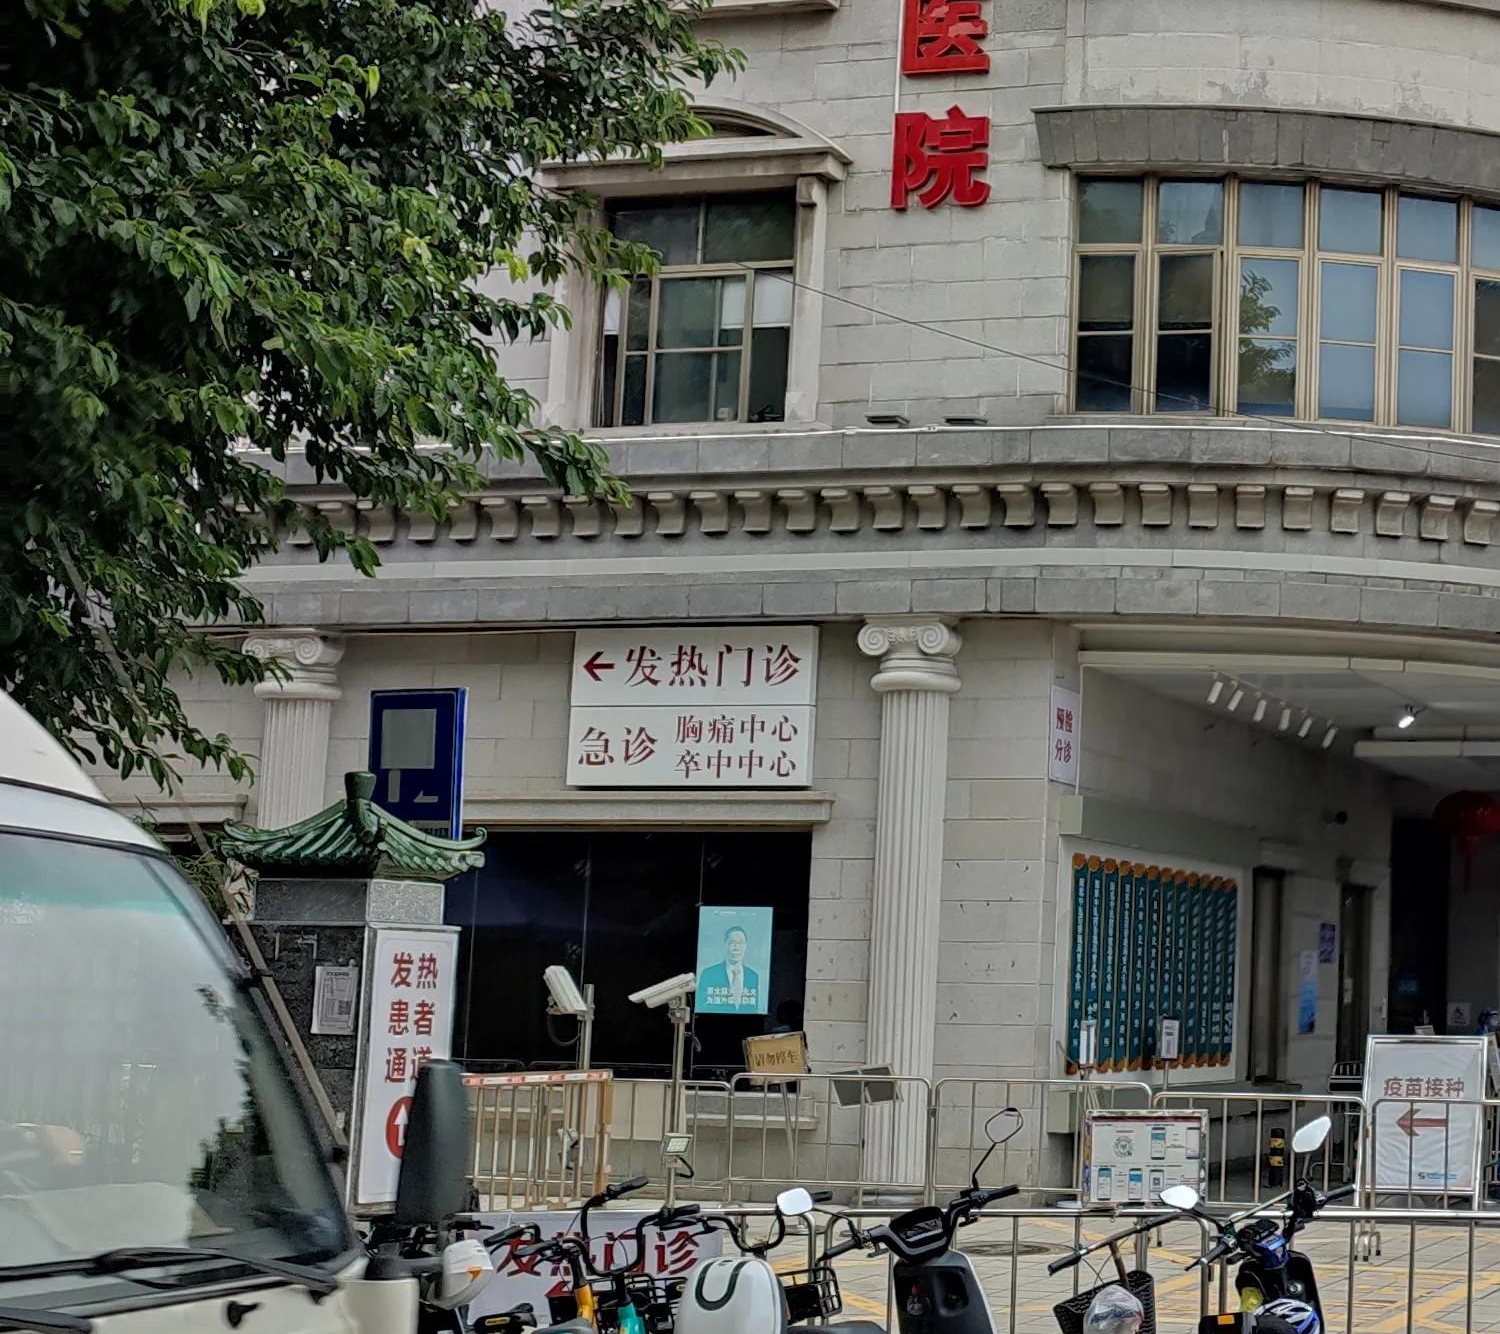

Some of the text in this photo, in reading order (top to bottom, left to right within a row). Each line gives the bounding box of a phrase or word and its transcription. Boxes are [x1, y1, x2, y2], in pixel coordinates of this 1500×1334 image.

[624, 644, 802, 687] 发热门诊
[577, 726, 658, 766] 急诊
[674, 714, 799, 744] 胸痛中心
[673, 748, 797, 779] 卒中中心
[391, 952, 439, 989] 发热
[387, 999, 436, 1037] 患者
[1383, 1077, 1465, 1098] 疫苗接种
